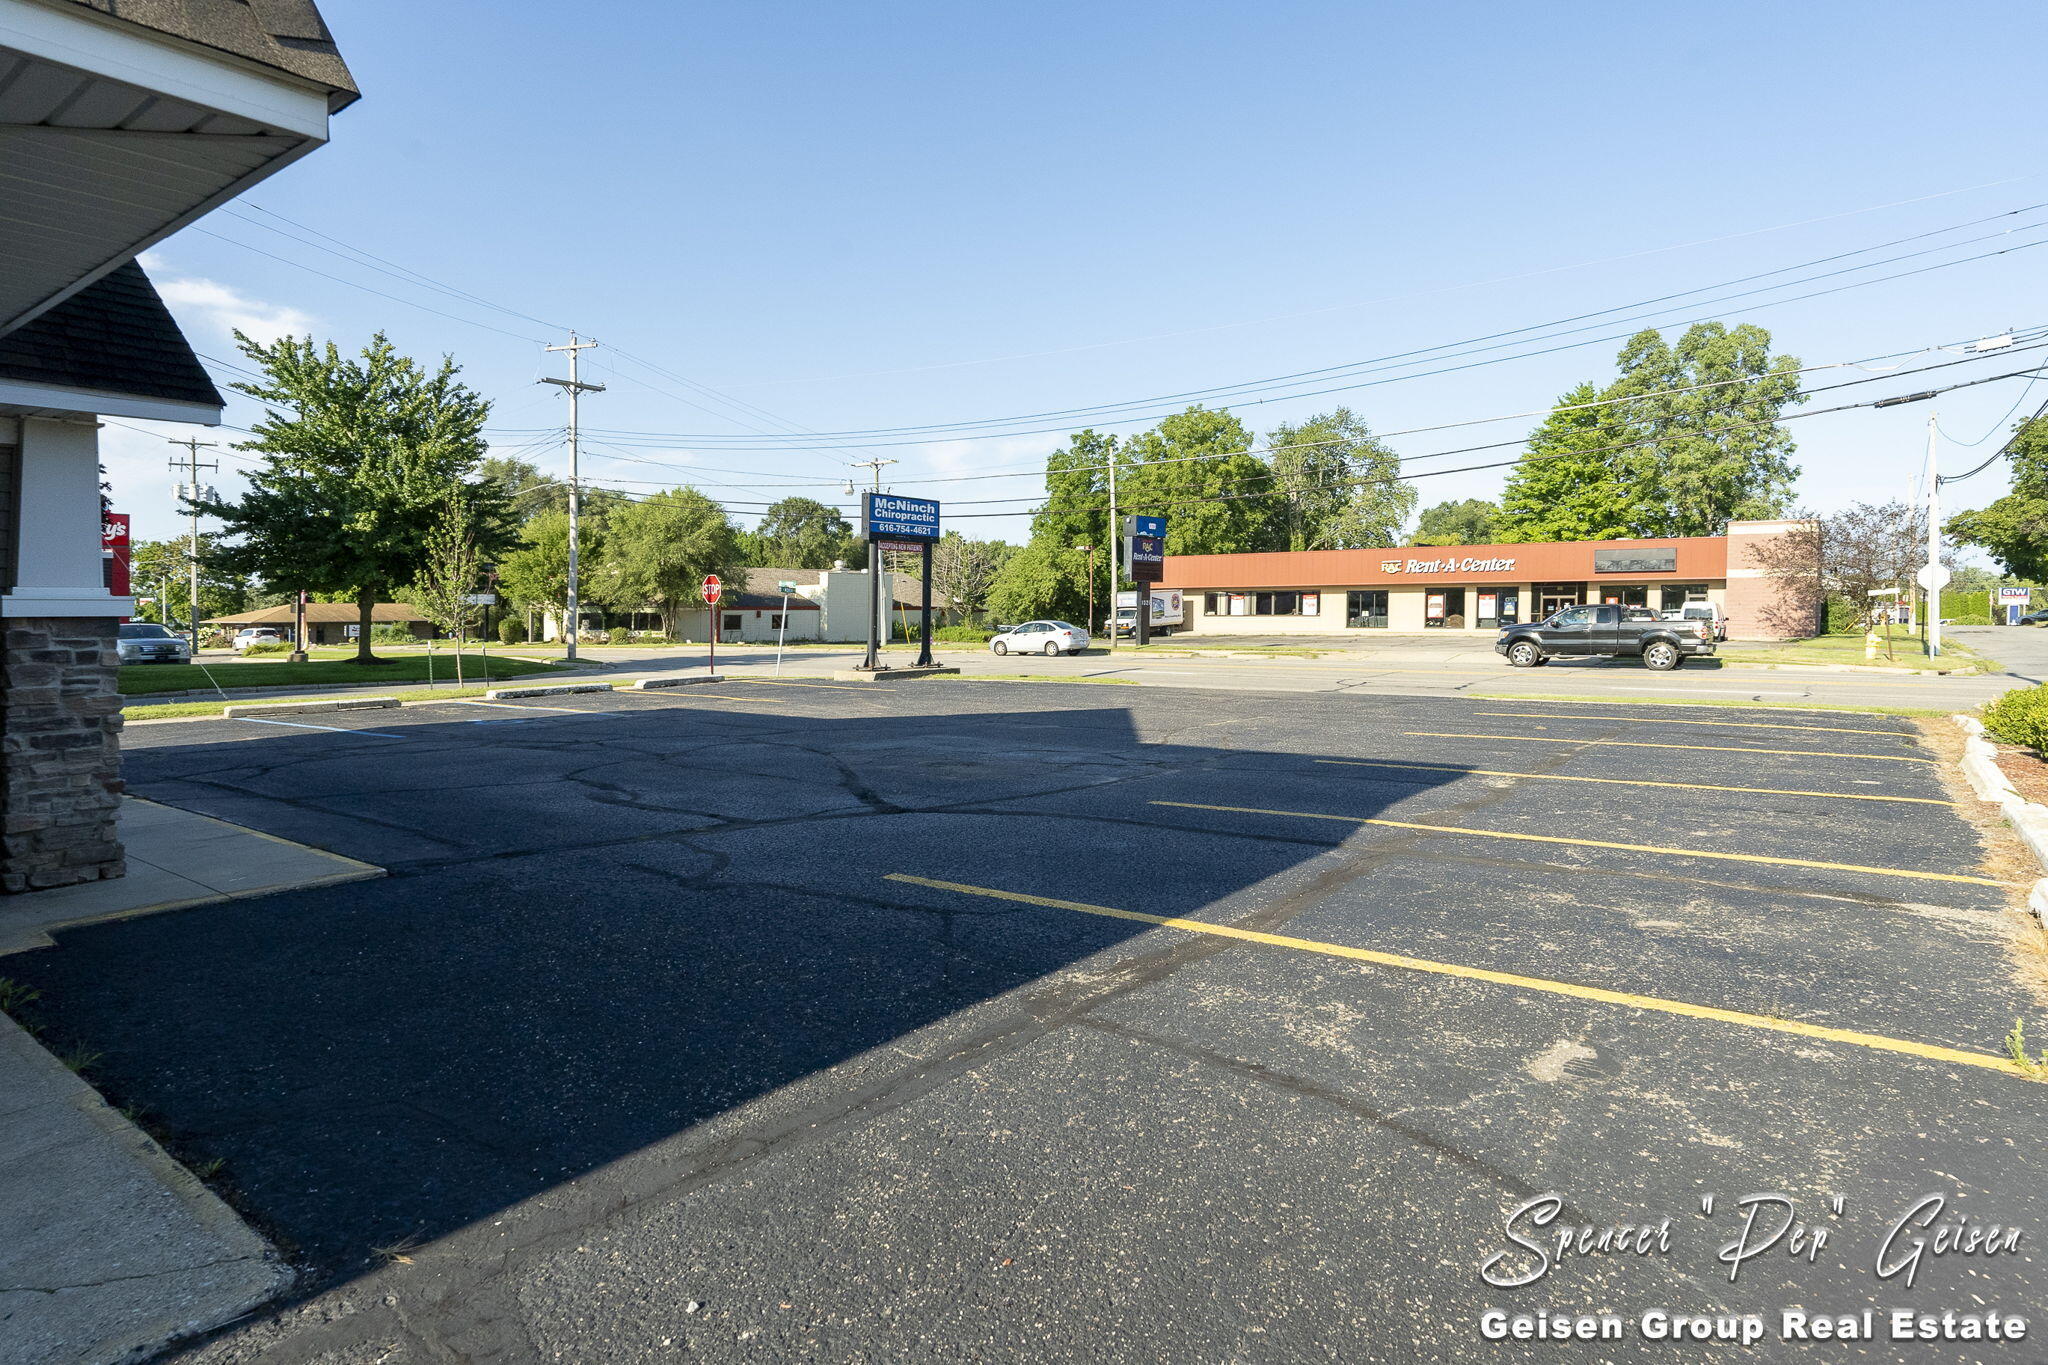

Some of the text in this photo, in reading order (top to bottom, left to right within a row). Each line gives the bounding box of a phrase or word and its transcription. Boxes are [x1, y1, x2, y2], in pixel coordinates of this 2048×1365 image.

[875, 498, 935, 513] McNinch
[875, 508, 935, 522] Chiropractic
[879, 524, 931, 535] 616-754-4621
[703, 584, 720, 595] STOP
